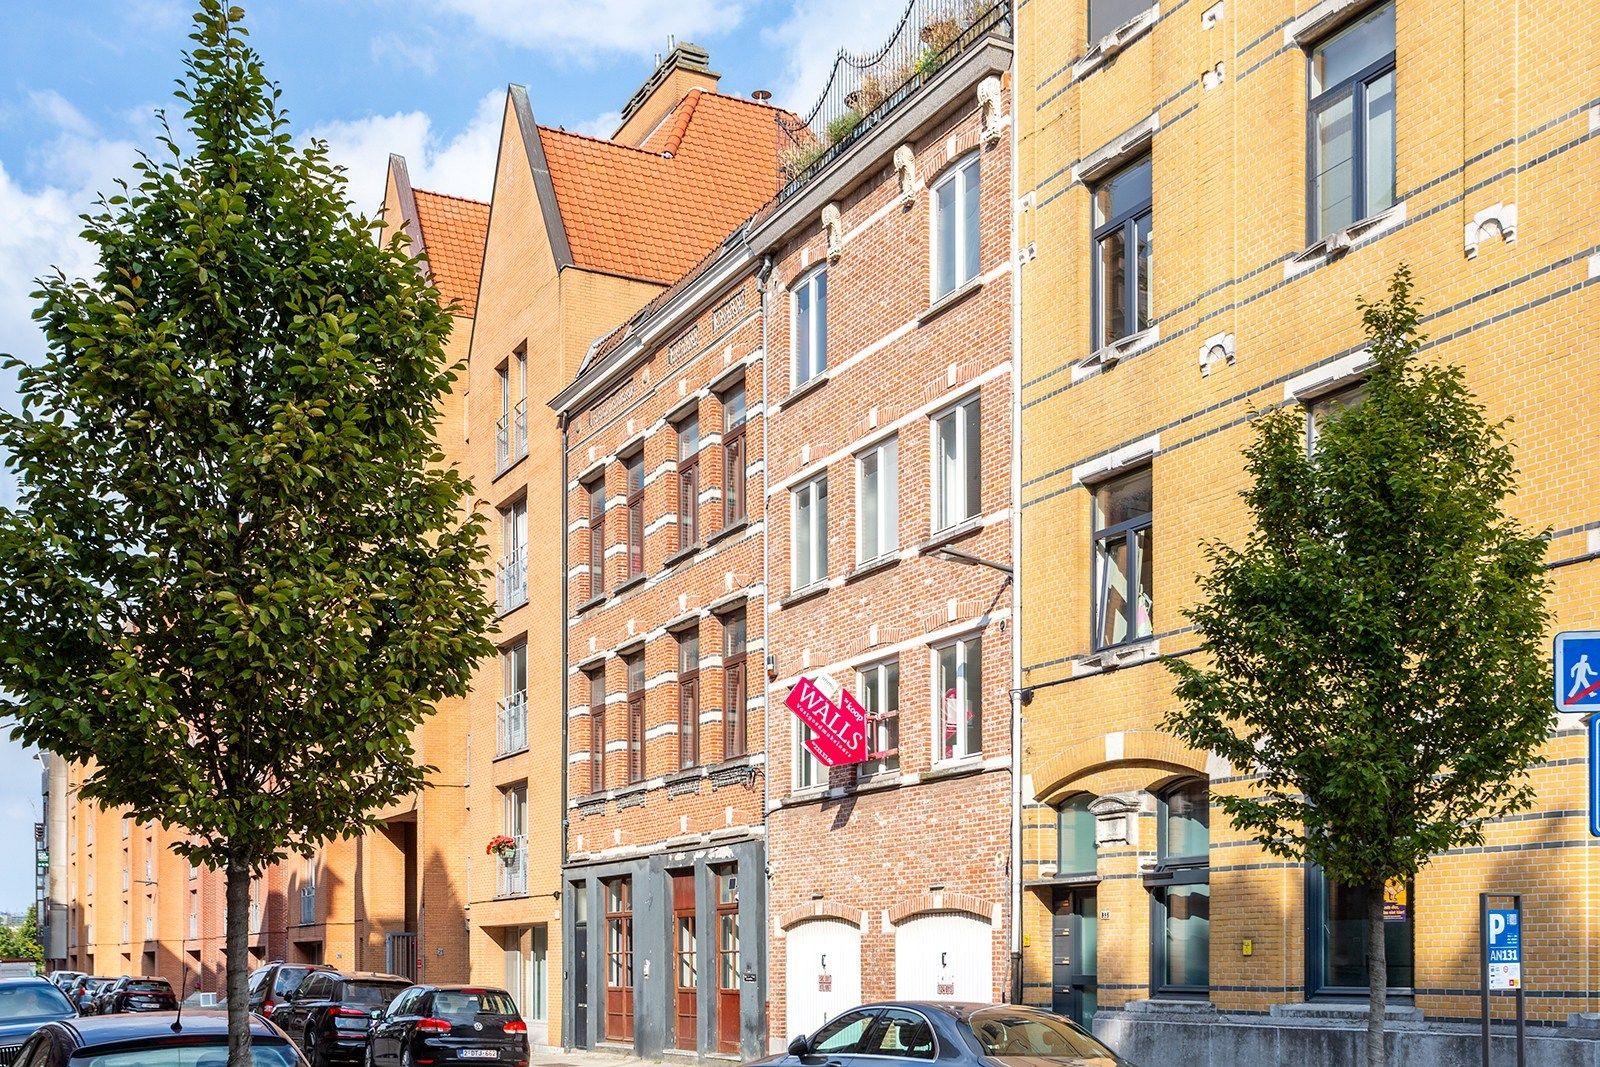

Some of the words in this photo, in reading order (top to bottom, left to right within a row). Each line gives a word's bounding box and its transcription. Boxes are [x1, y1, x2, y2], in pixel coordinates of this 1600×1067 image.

[800, 683, 863, 750] WALLS
[846, 702, 864, 722] koop
[1489, 913, 1505, 945] P
[1490, 949, 1518, 961] AN131
